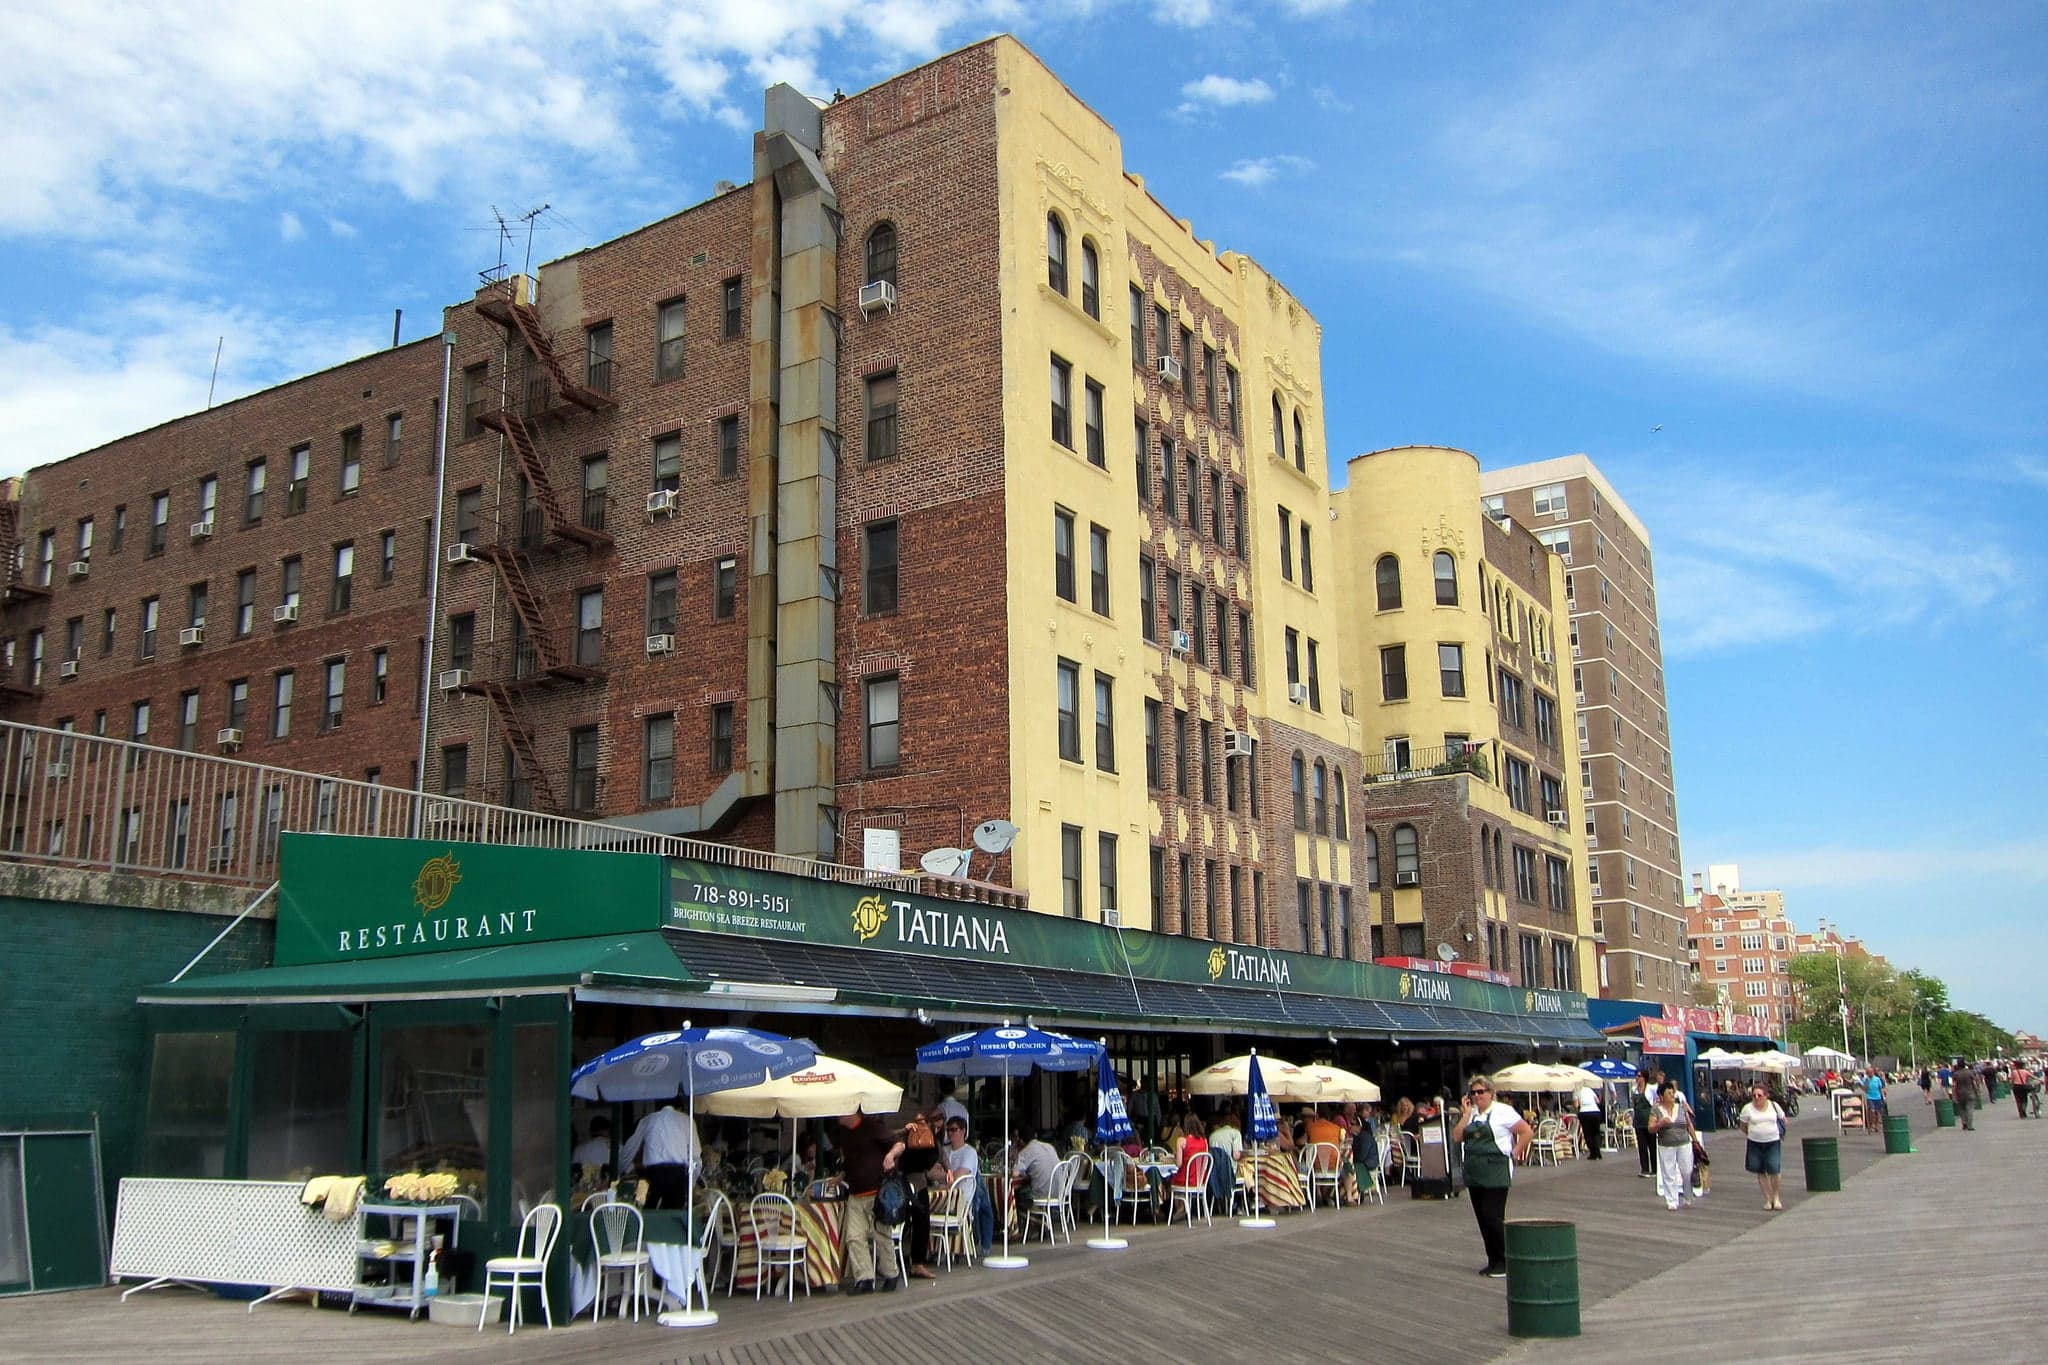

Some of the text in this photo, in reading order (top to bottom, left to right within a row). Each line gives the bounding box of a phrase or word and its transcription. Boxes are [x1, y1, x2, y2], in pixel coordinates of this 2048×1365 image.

[693, 884, 790, 914] 718-891-5151
[338, 909, 537, 951] RESTAURANT
[673, 907, 807, 933] BRIGHTON SEA BREEZE RESTAURANT
